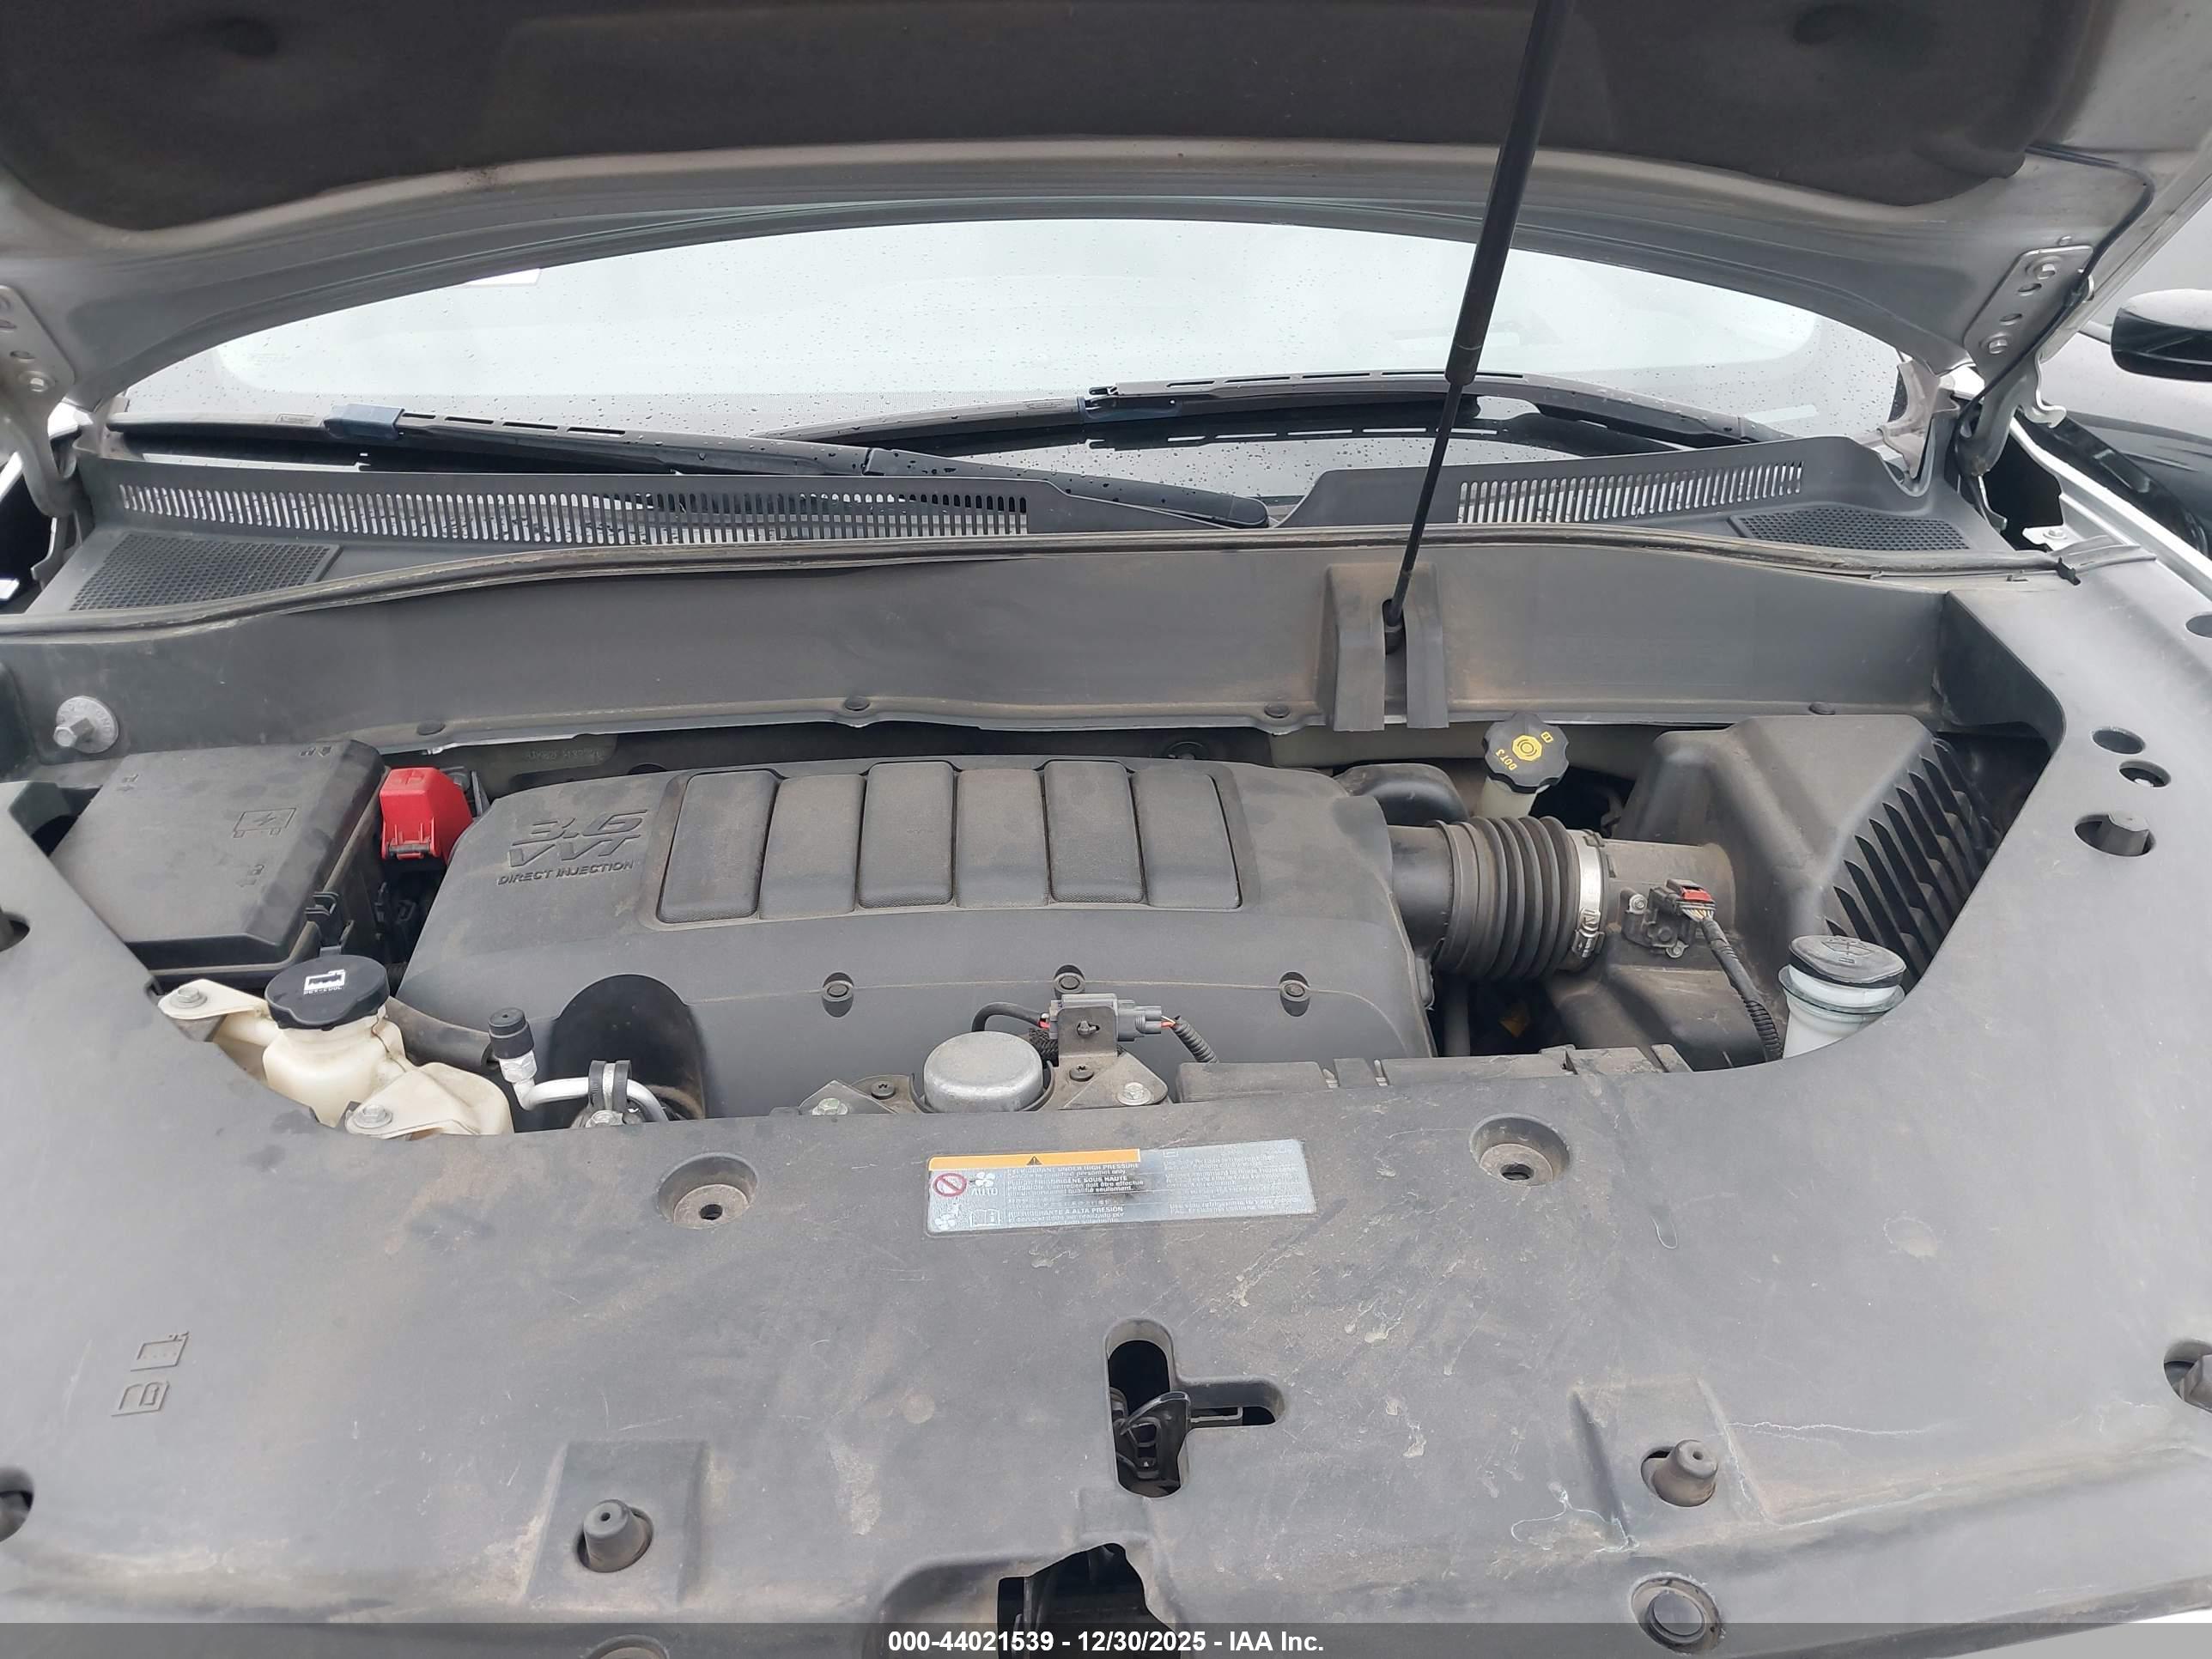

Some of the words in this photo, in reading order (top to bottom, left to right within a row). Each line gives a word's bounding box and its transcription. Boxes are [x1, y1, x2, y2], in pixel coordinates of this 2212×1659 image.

[512, 809, 648, 847] 3.6
[508, 834, 641, 868] VVT
[497, 870, 553, 885] DIRECT
[556, 860, 634, 878] INJECTION
[970, 1187, 998, 1197] AUTO
